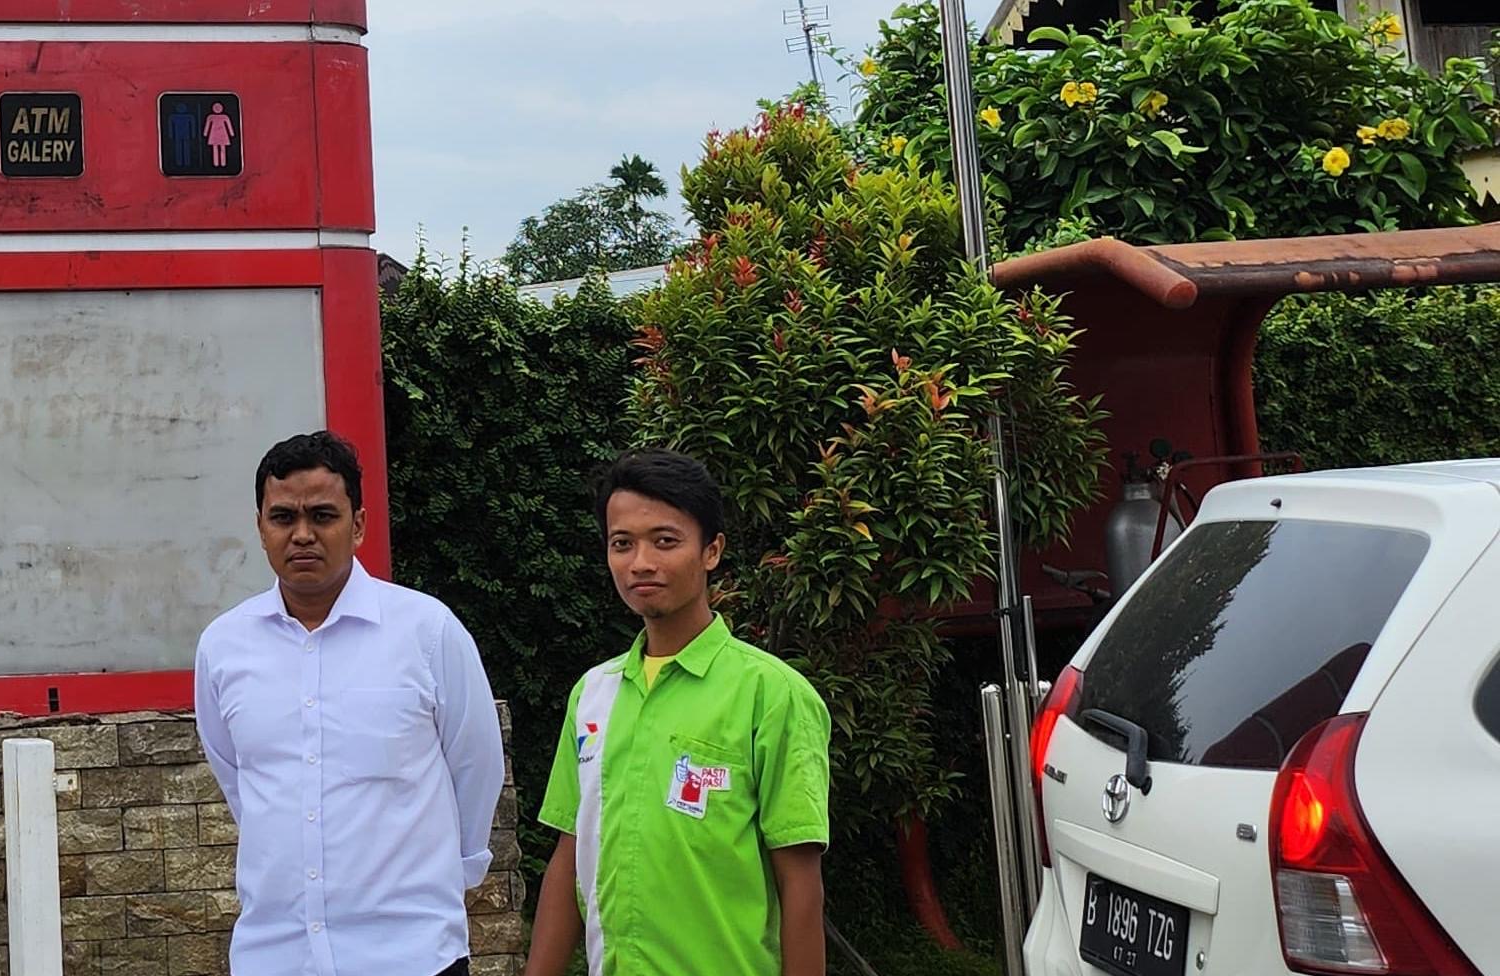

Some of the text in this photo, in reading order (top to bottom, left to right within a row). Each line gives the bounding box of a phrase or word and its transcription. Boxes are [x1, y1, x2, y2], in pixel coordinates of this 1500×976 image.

[12, 107, 70, 134] ATM
[7, 140, 76, 163] GALERY
[1087, 887, 1175, 961] B 1896 TZG
